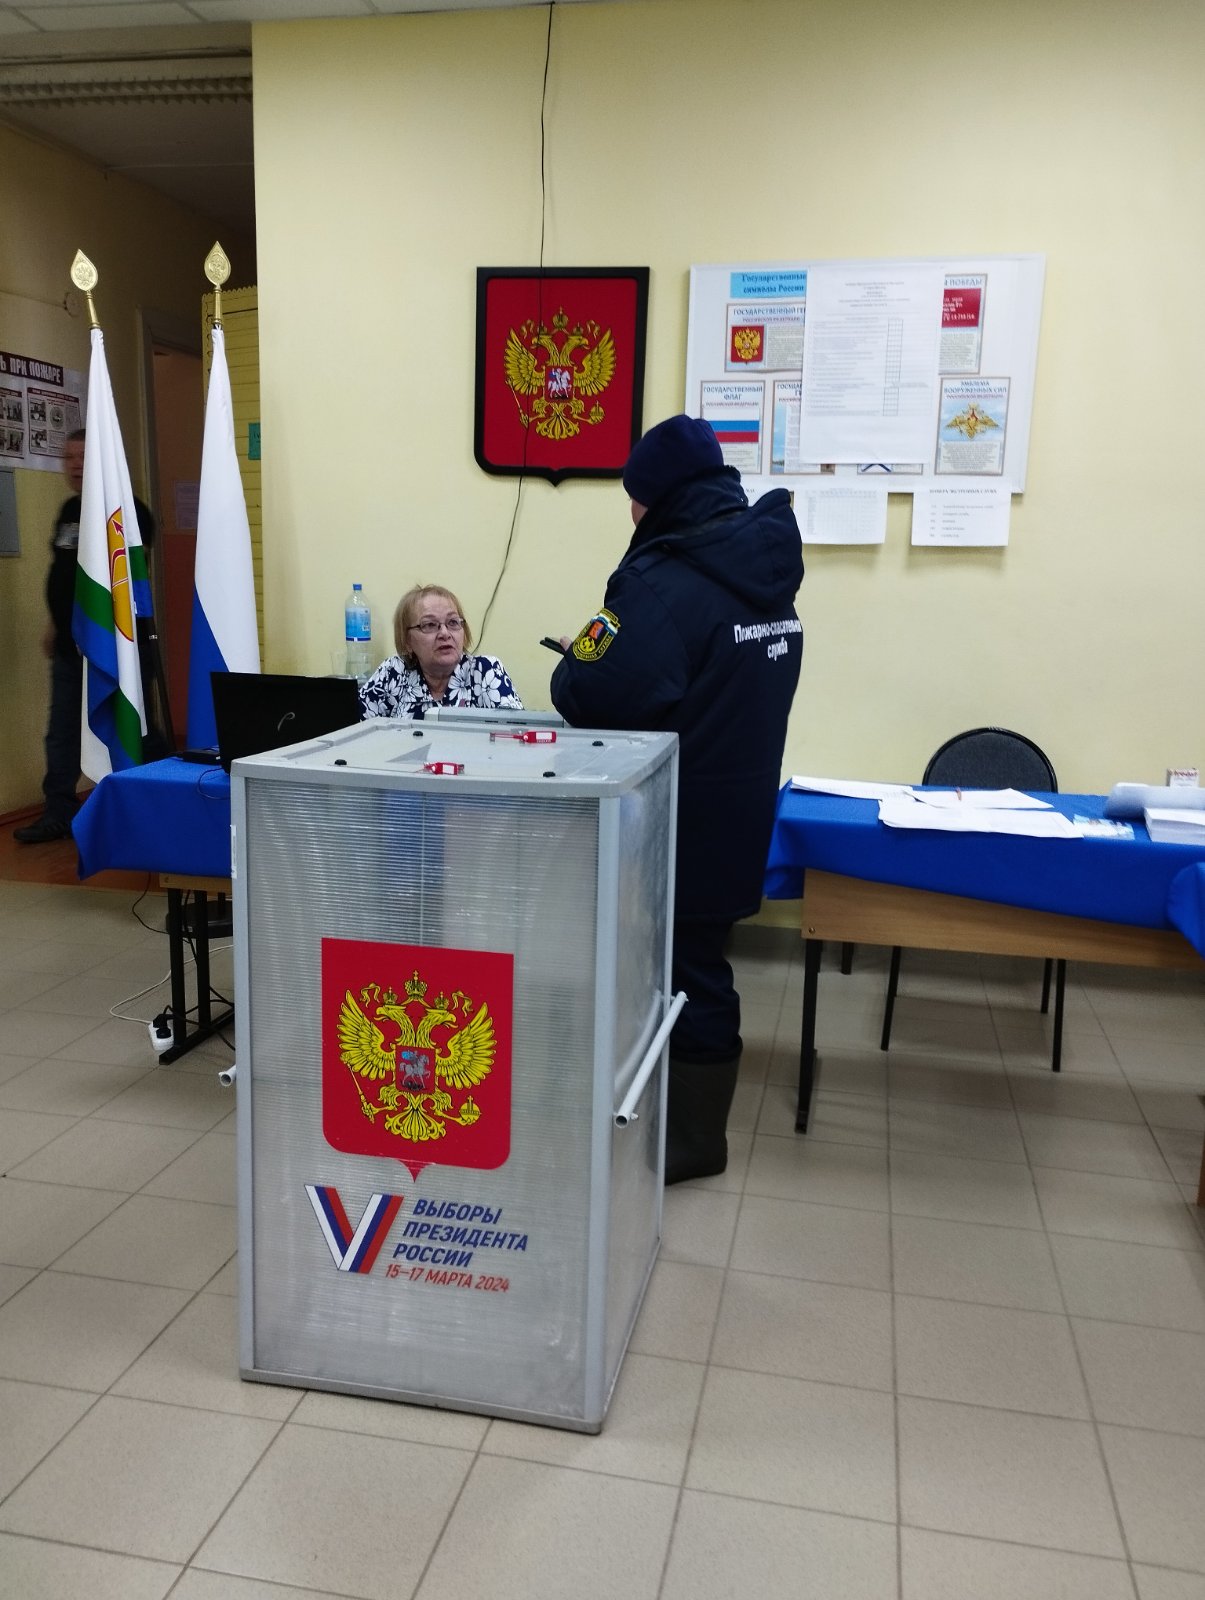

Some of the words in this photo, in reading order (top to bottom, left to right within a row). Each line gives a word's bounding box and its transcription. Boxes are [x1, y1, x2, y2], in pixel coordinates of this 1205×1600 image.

[778, 284, 804, 292] России
[9, 357, 28, 376] ПРИ
[29, 361, 61, 383] ПОЖАРЕ
[703, 385, 763, 394] ГОСУДАРСТВЕННЫЙ
[723, 393, 742, 401] ФЛАГ
[767, 636, 788, 661] служба
[412, 1199, 503, 1225] ВЫБОРЫ
[402, 1221, 529, 1252] ПРЕЗИДЕНТА
[392, 1243, 474, 1268] РОССИИ
[425, 1271, 473, 1289] МАРТА
[474, 1277, 510, 1293] 2024
